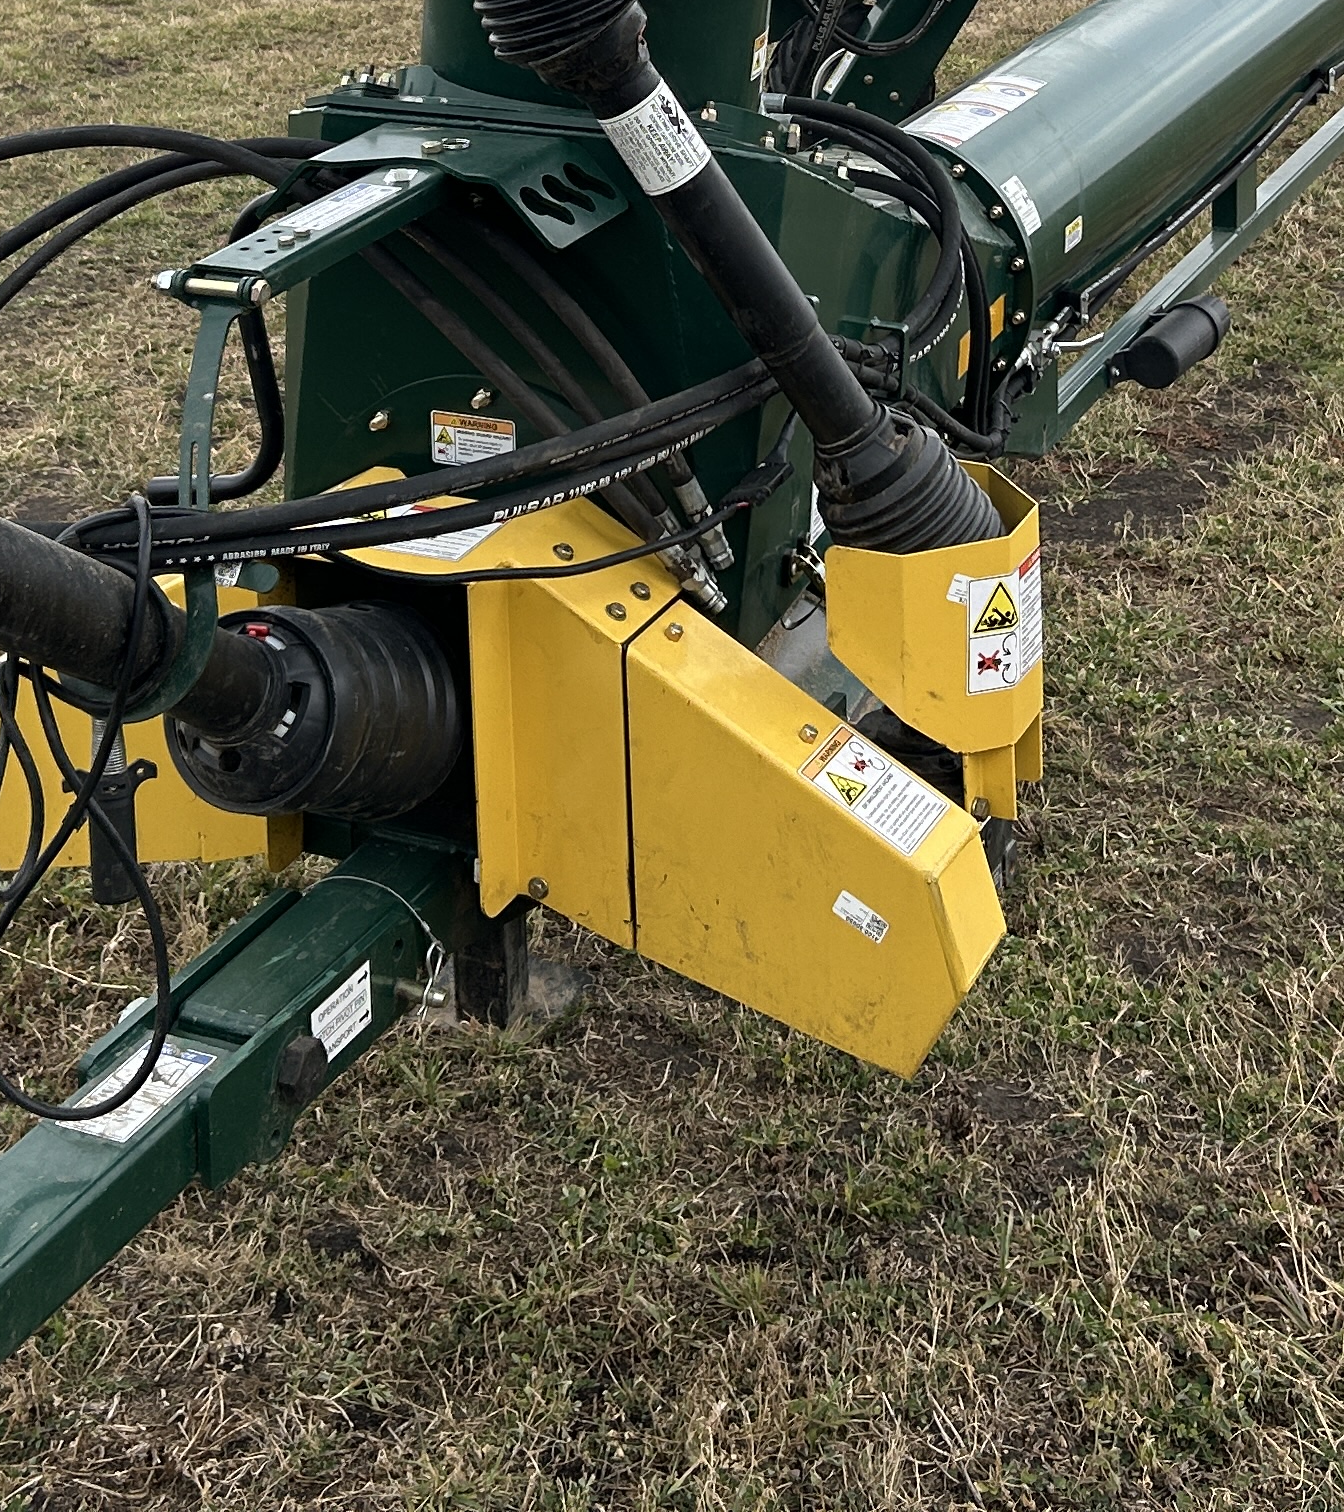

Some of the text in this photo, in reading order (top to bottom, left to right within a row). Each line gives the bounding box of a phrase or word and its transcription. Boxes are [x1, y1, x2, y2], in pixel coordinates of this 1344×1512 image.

[810, 10, 832, 52] PULSAR
[645, 123, 663, 144] KEEP
[459, 419, 497, 431] WARNING
[492, 493, 565, 523] PULSAR
[318, 983, 353, 1022] OPERATION
[328, 1021, 356, 1053] ANSPORT
